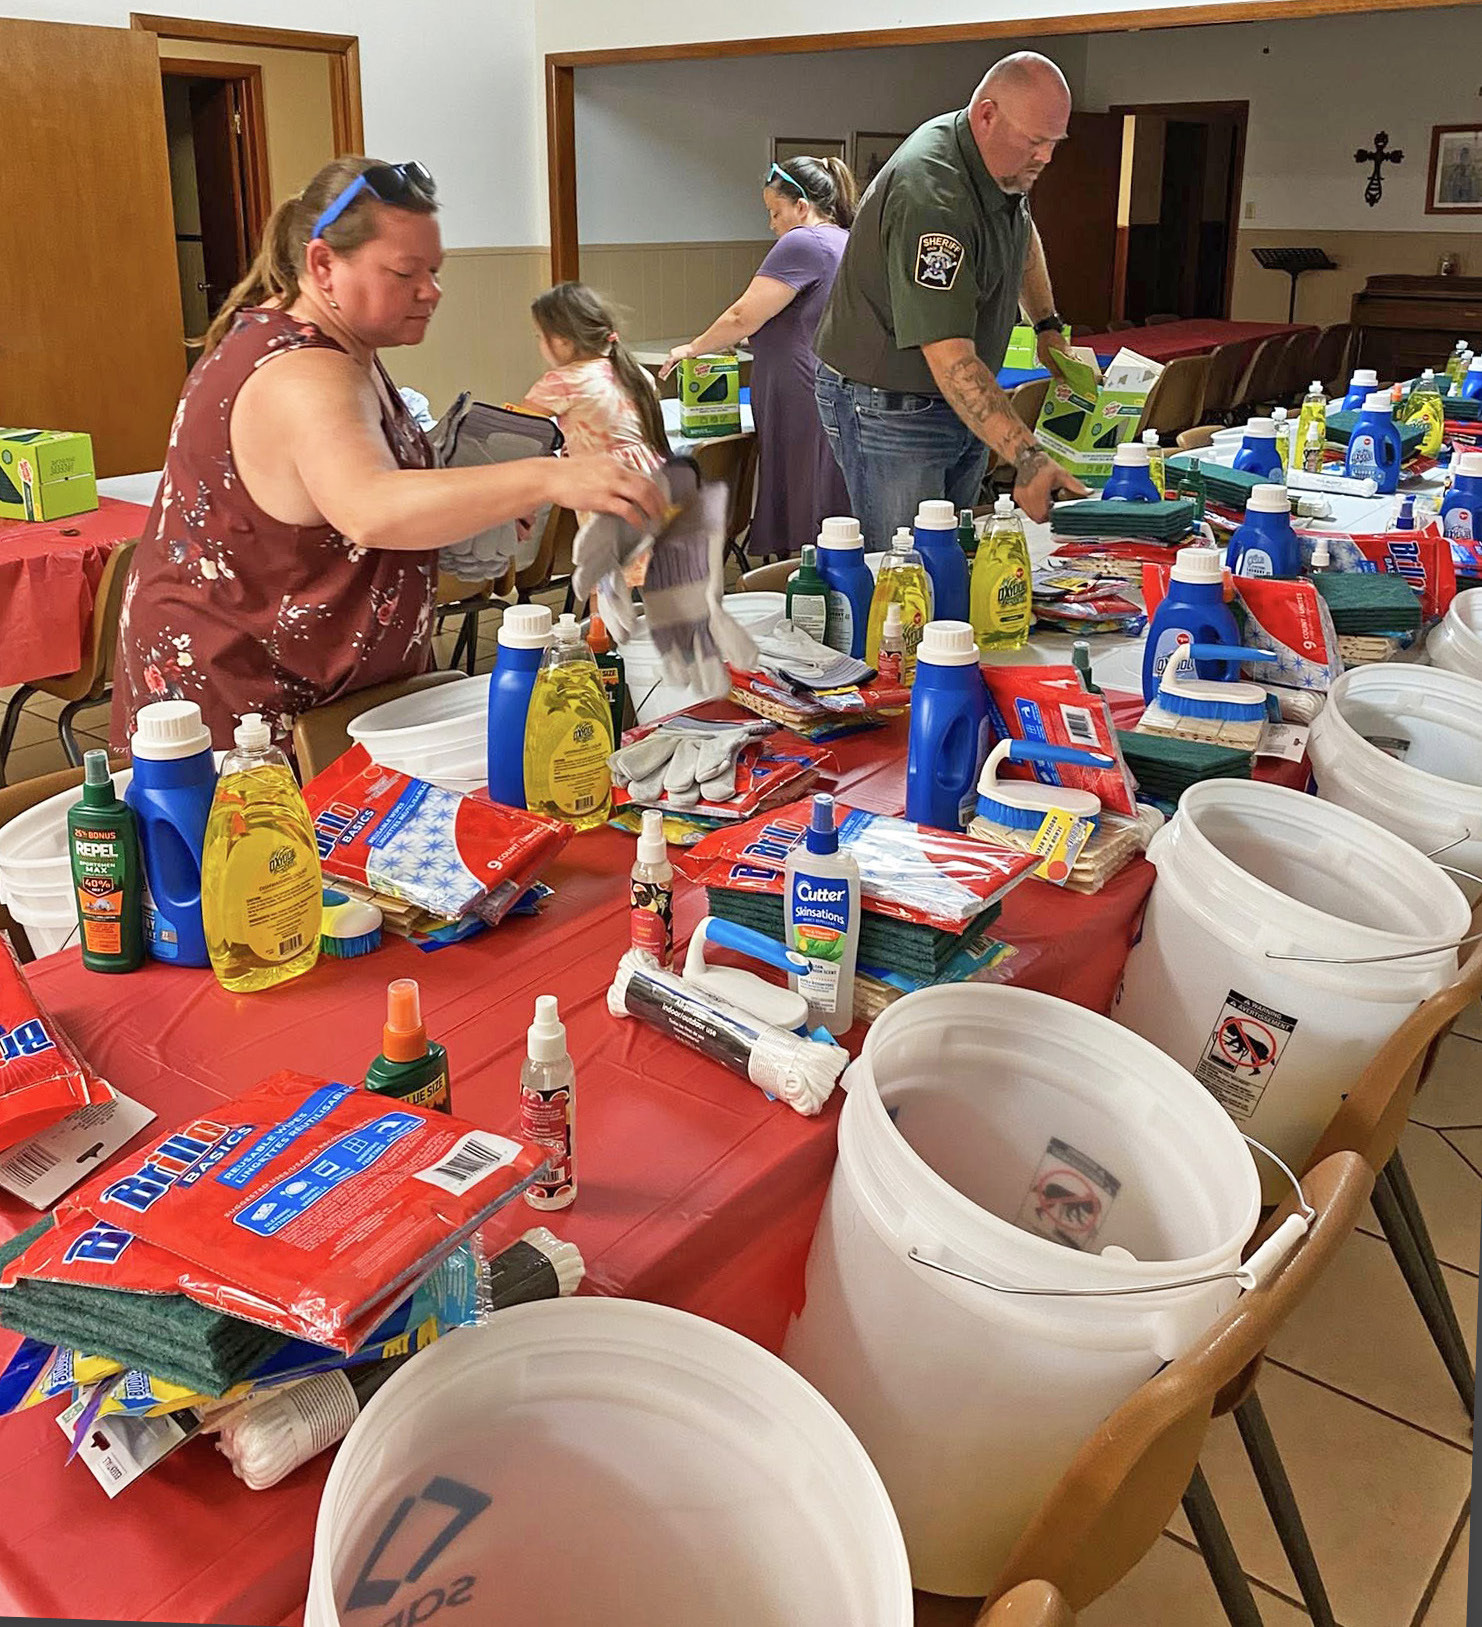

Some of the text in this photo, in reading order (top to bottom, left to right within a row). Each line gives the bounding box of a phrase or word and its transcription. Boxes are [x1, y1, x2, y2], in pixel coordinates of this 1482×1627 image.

[923, 237, 961, 252] SHERIFF
[1303, 641, 1317, 650] 9
[88, 831, 116, 840] BONUS
[343, 809, 375, 843] BASICS
[75, 841, 118, 857] REPEL
[743, 818, 807, 861] Brillo
[79, 860, 115, 868] SPORTSMEN
[487, 861, 503, 870] 9
[498, 843, 520, 860] COUNT
[85, 866, 108, 874] MAX
[85, 879, 111, 888] 40%
[797, 882, 846, 902] Cutter
[795, 906, 845, 925] Skinsations
[662, 1002, 717, 1037] Indoor/outdoor use
[1238, 1004, 1290, 1030] AVERTISSEMENT
[1252, 1001, 1282, 1019] WARNING
[402, 1076, 443, 1104] LUE SIZE
[184, 1126, 253, 1184] BASICS
[223, 1112, 308, 1180] REUSABLE WIPES
[100, 1121, 230, 1213] Brillo
[235, 1136, 290, 1184] LINGETTES
[224, 1181, 269, 1217] SUGGESTED
[264, 1208, 291, 1228] CLEANING
